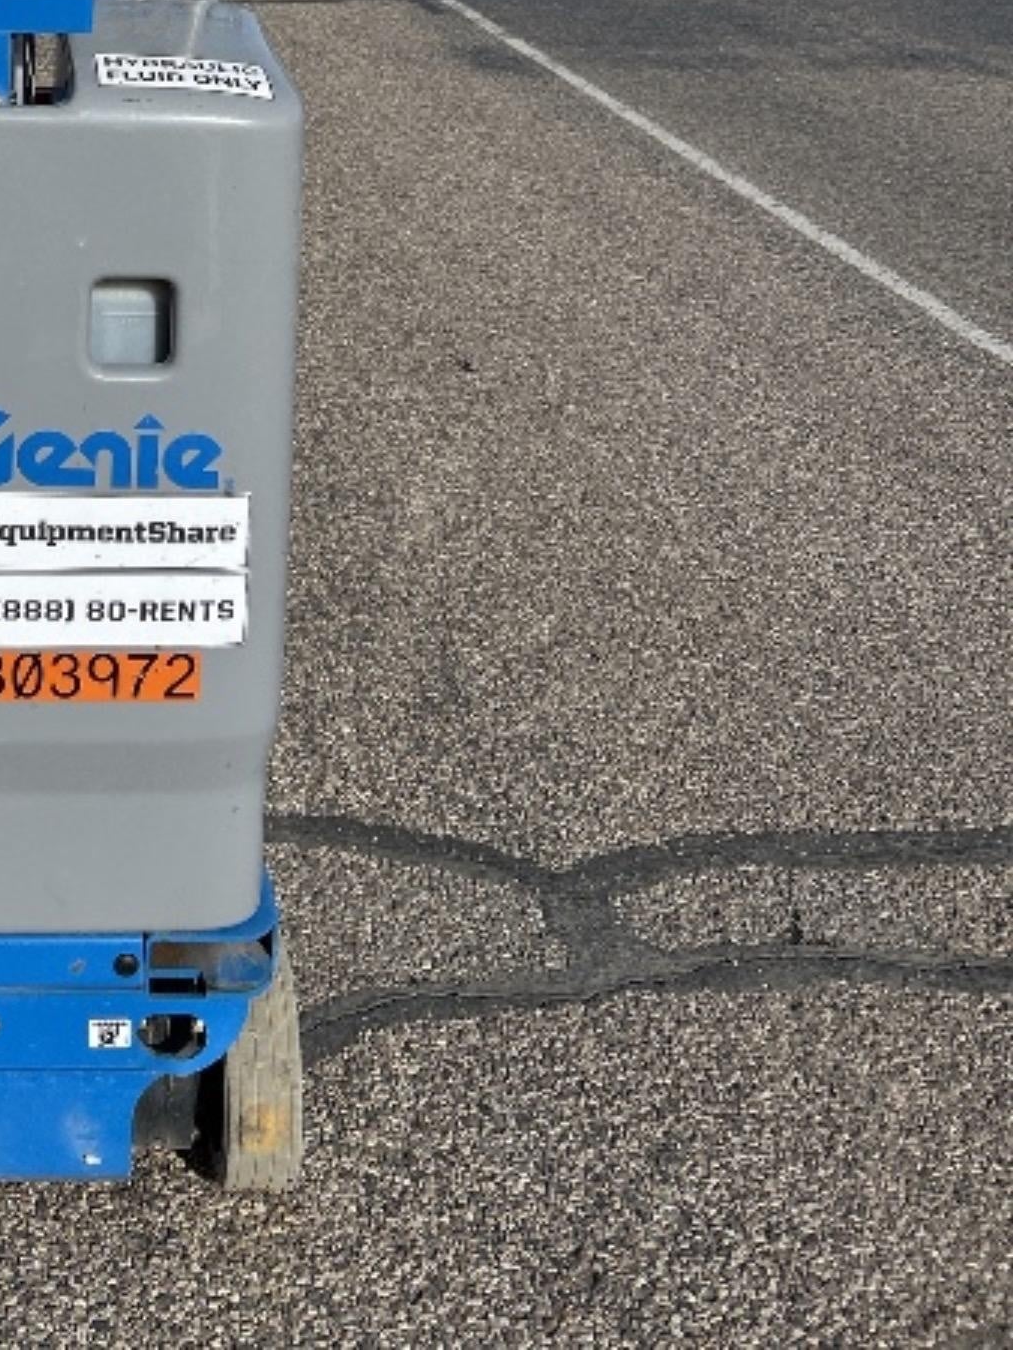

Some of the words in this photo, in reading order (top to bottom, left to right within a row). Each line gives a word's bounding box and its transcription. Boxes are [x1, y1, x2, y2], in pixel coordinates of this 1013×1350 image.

[103, 57, 259, 76] HYDRAULIC
[106, 71, 184, 82] FLUID
[193, 74, 262, 91] ONLY
[86, 599, 235, 622] 80-RENTS
